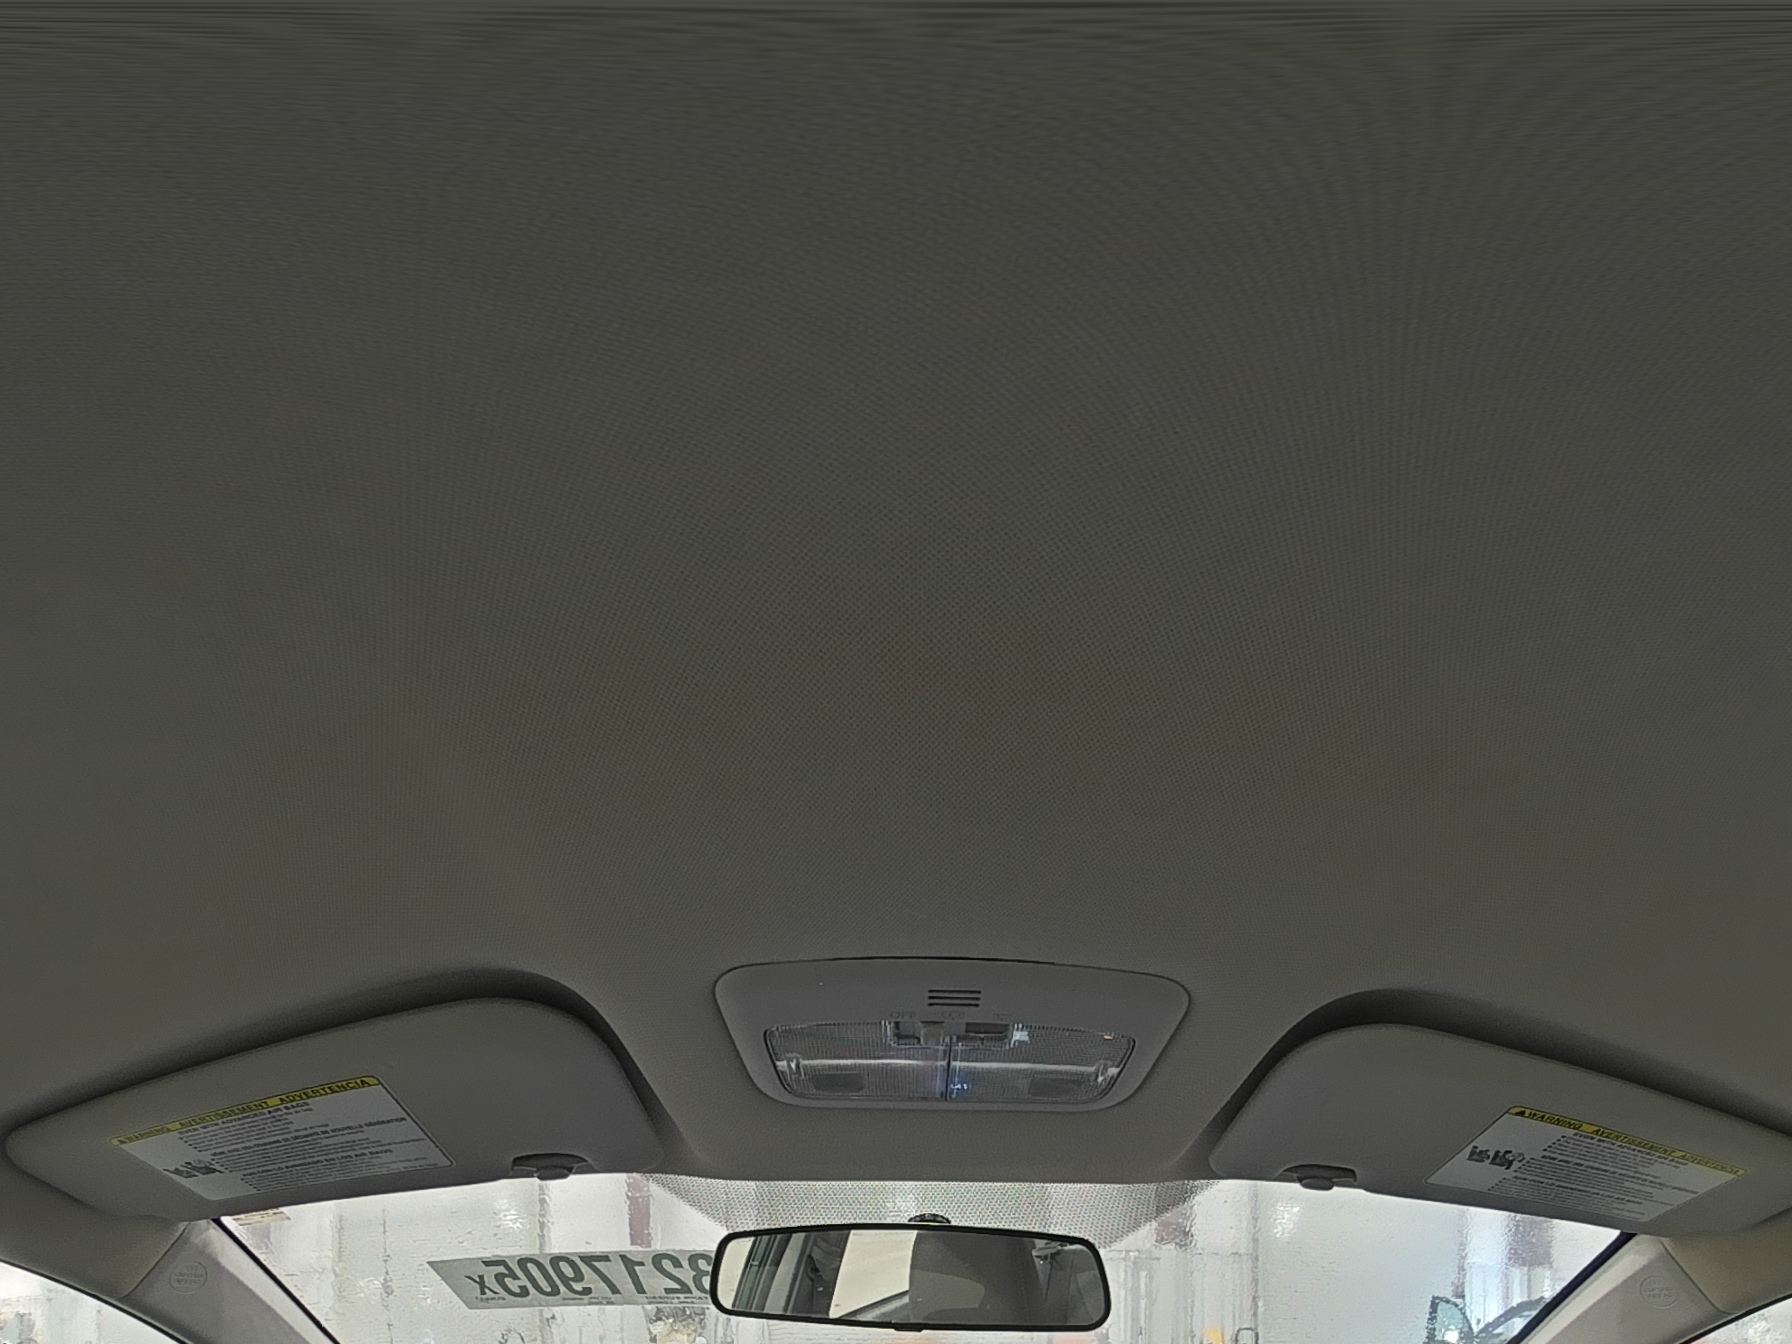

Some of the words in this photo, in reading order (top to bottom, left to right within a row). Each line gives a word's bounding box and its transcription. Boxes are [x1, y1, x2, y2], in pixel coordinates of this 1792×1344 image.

[178, 1101, 271, 1127] AVERTISSEMENT
[278, 1078, 370, 1105] ADVERTENCIA
[1524, 1110, 1584, 1130] WARNING
